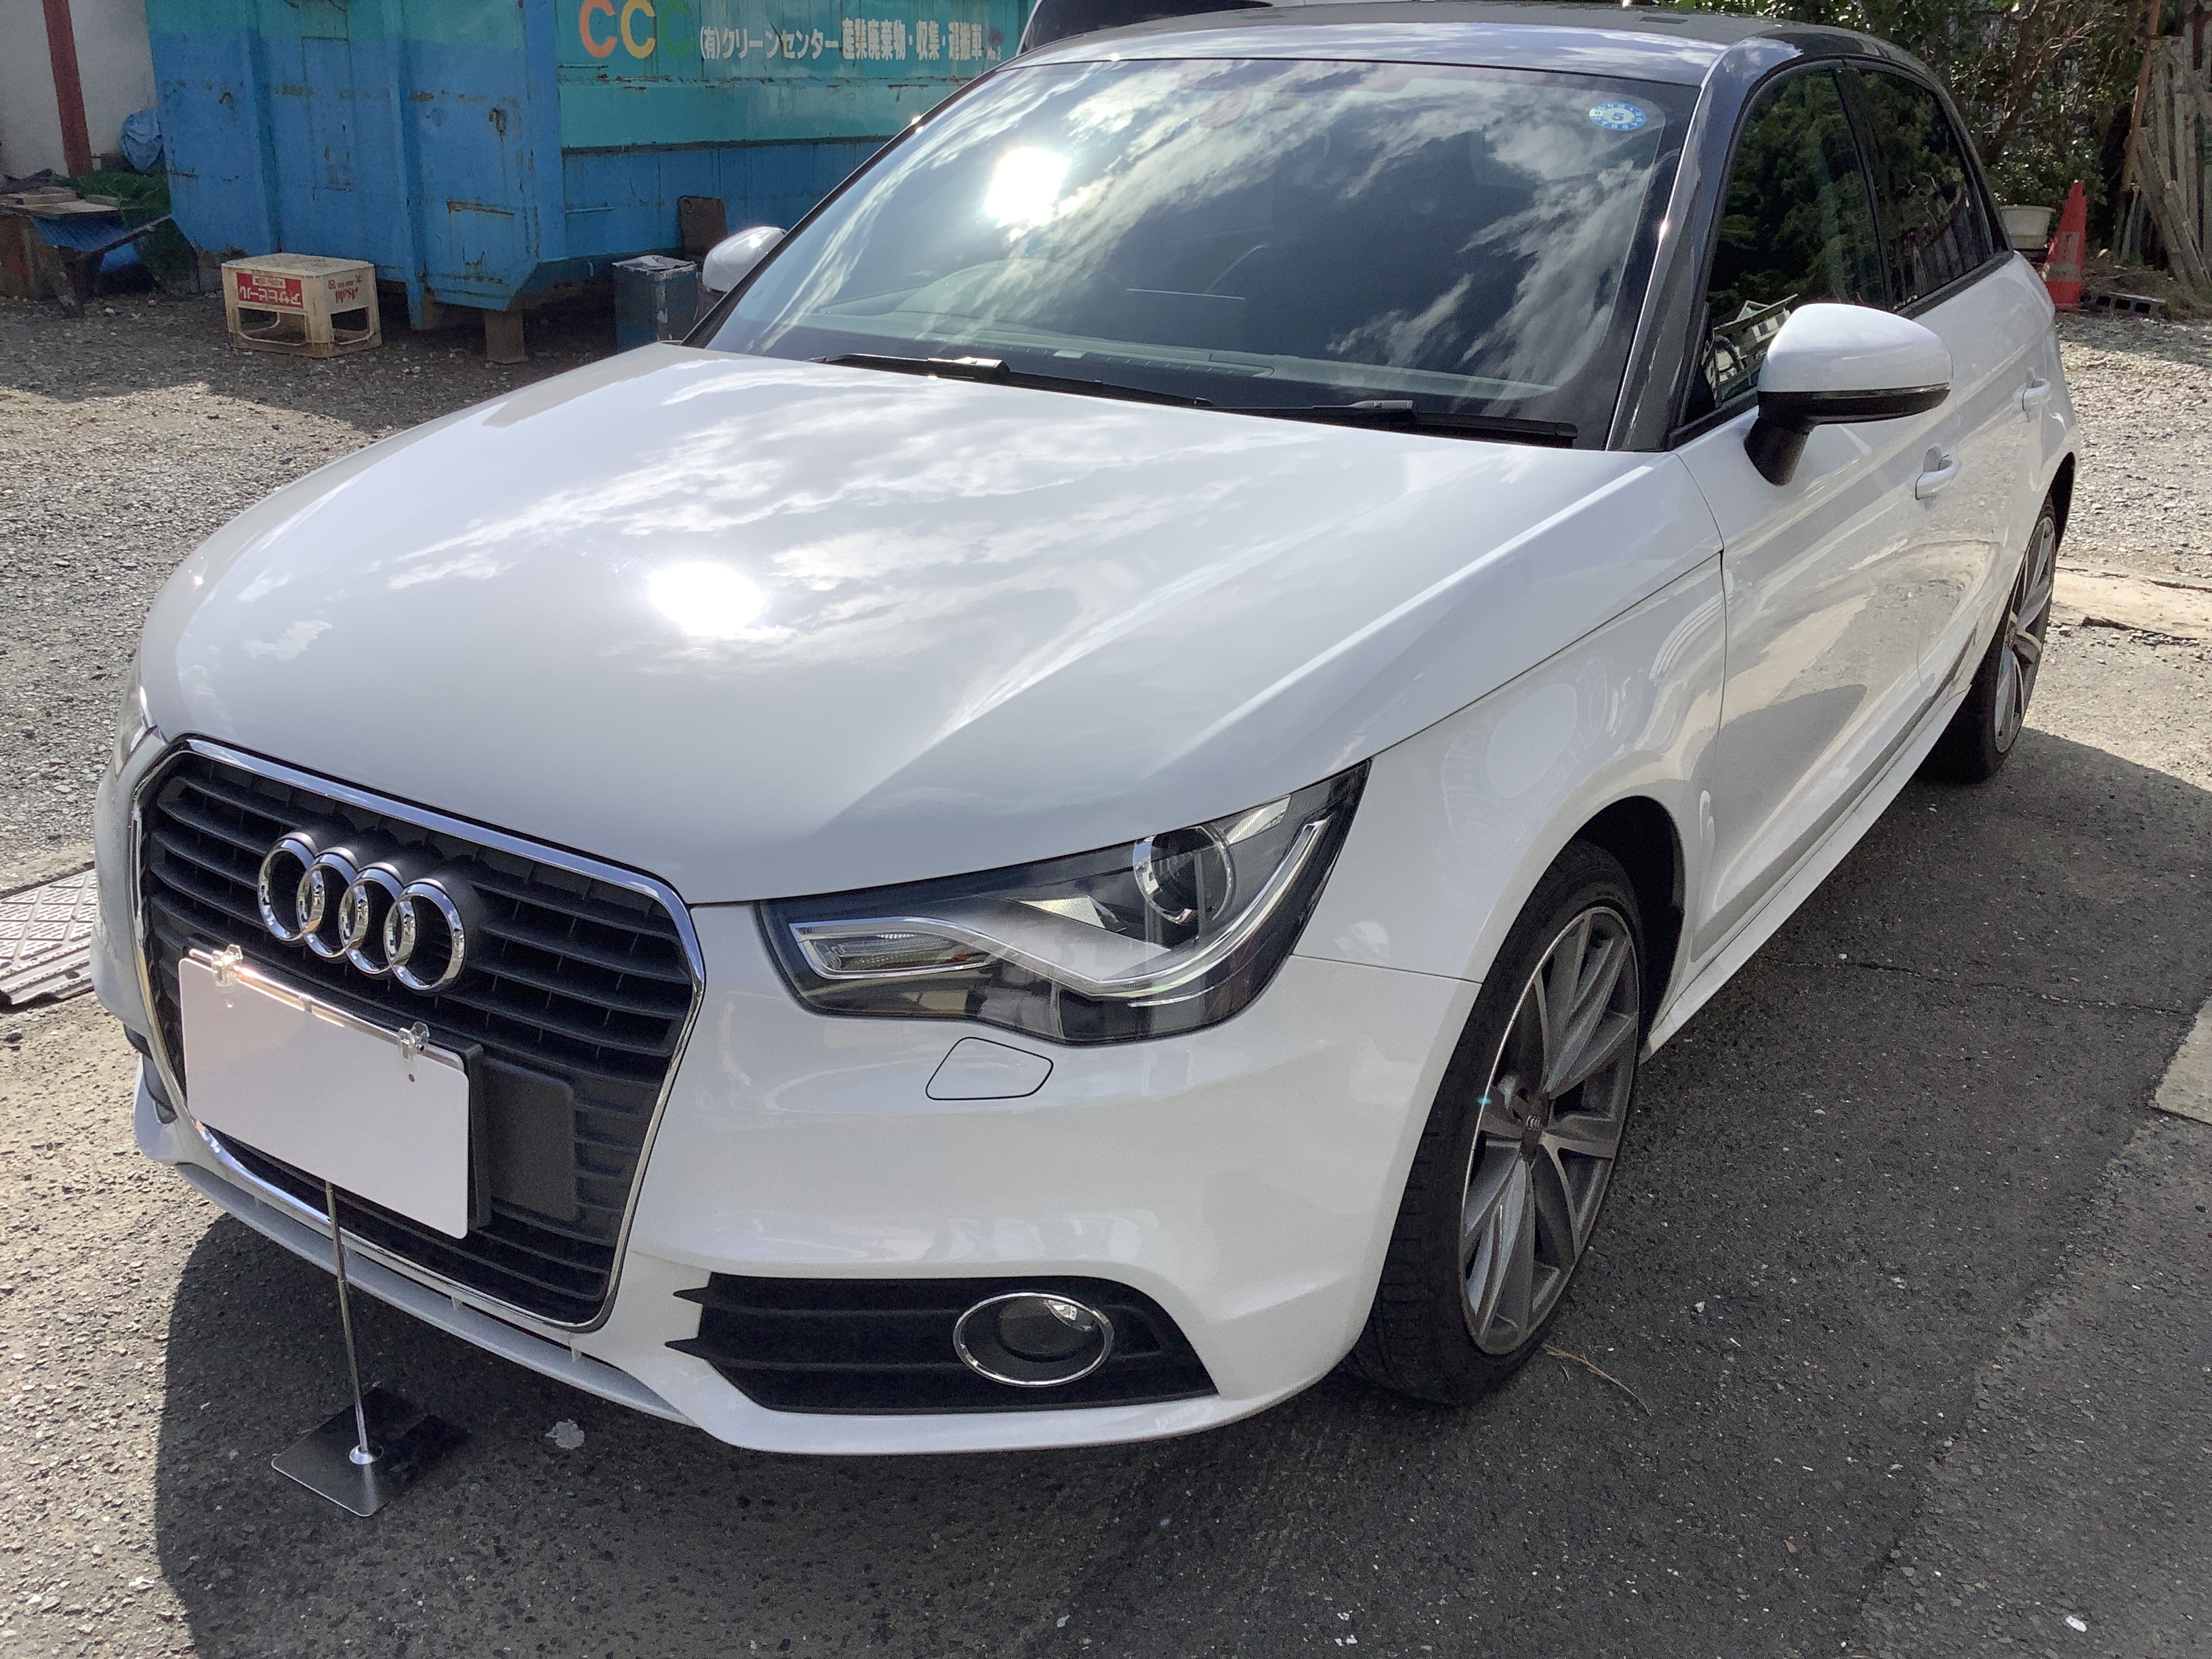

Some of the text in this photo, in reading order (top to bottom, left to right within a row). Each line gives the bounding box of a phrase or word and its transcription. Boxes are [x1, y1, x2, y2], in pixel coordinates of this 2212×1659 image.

[239, 285, 302, 305] アサヒビール
